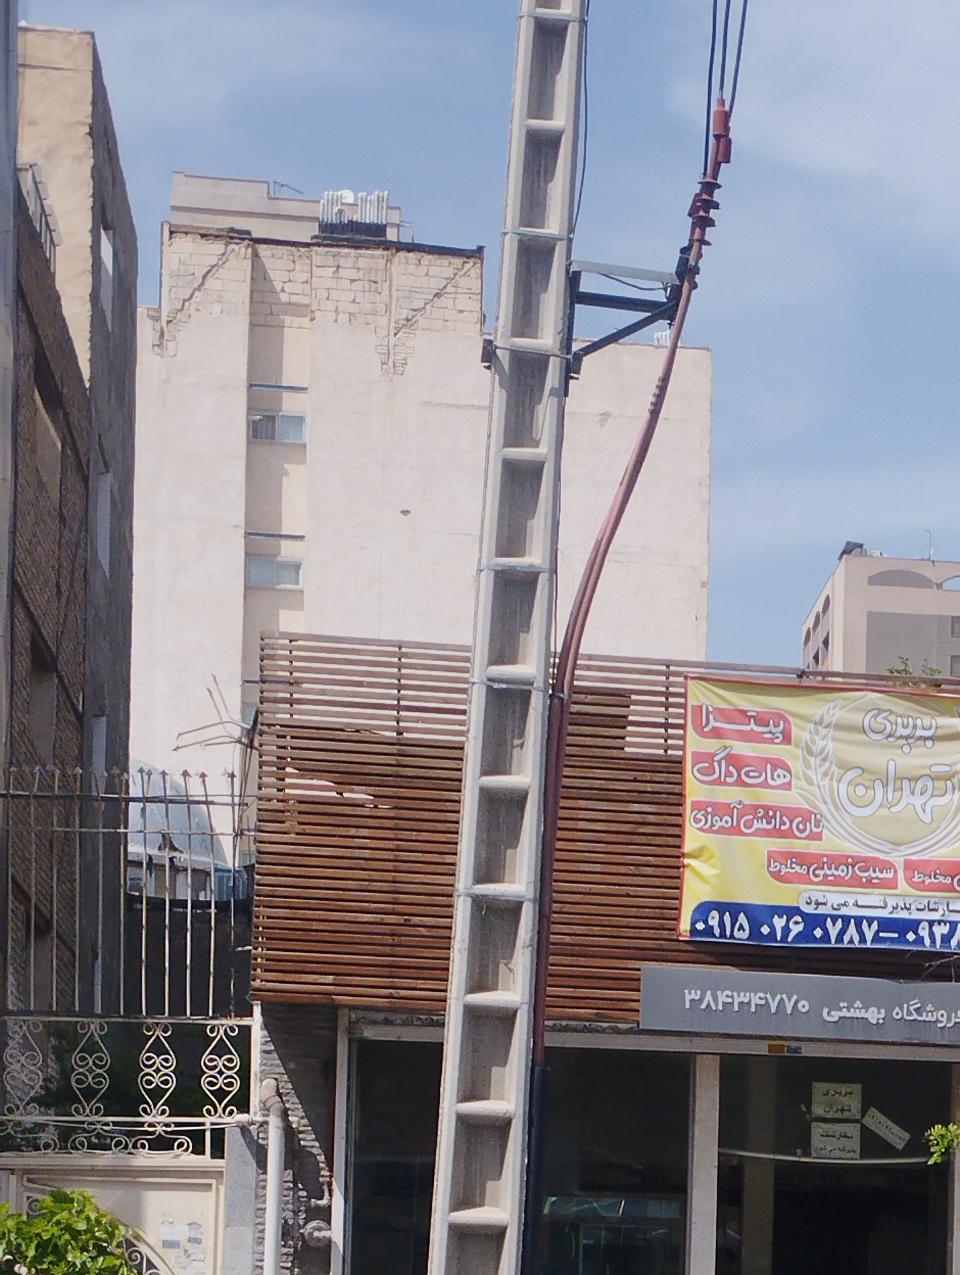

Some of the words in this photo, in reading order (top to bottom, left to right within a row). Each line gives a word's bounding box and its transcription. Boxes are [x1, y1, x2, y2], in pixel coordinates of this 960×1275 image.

[702, 704, 785, 743] پیتزا
[862, 708, 938, 755] بربری
[692, 745, 738, 783] داگ
[741, 763, 792, 786] هات
[837, 759, 955, 825] تهران
[690, 801, 743, 830] آموزی
[740, 808, 791, 834] دانش
[792, 813, 824, 838] نان
[768, 859, 807, 875] مخلوط
[809, 856, 852, 881] زمینی
[854, 862, 895, 883] سیب
[912, 869, 952, 888] مخلوط
[695, 910, 750, 940] ۰۹۱۵
[760, 914, 805, 942] ۰۲۶
[684, 990, 809, 1015] ۳۸۴۳۴۷۷۰
[822, 1000, 886, 1024] بهشتی
